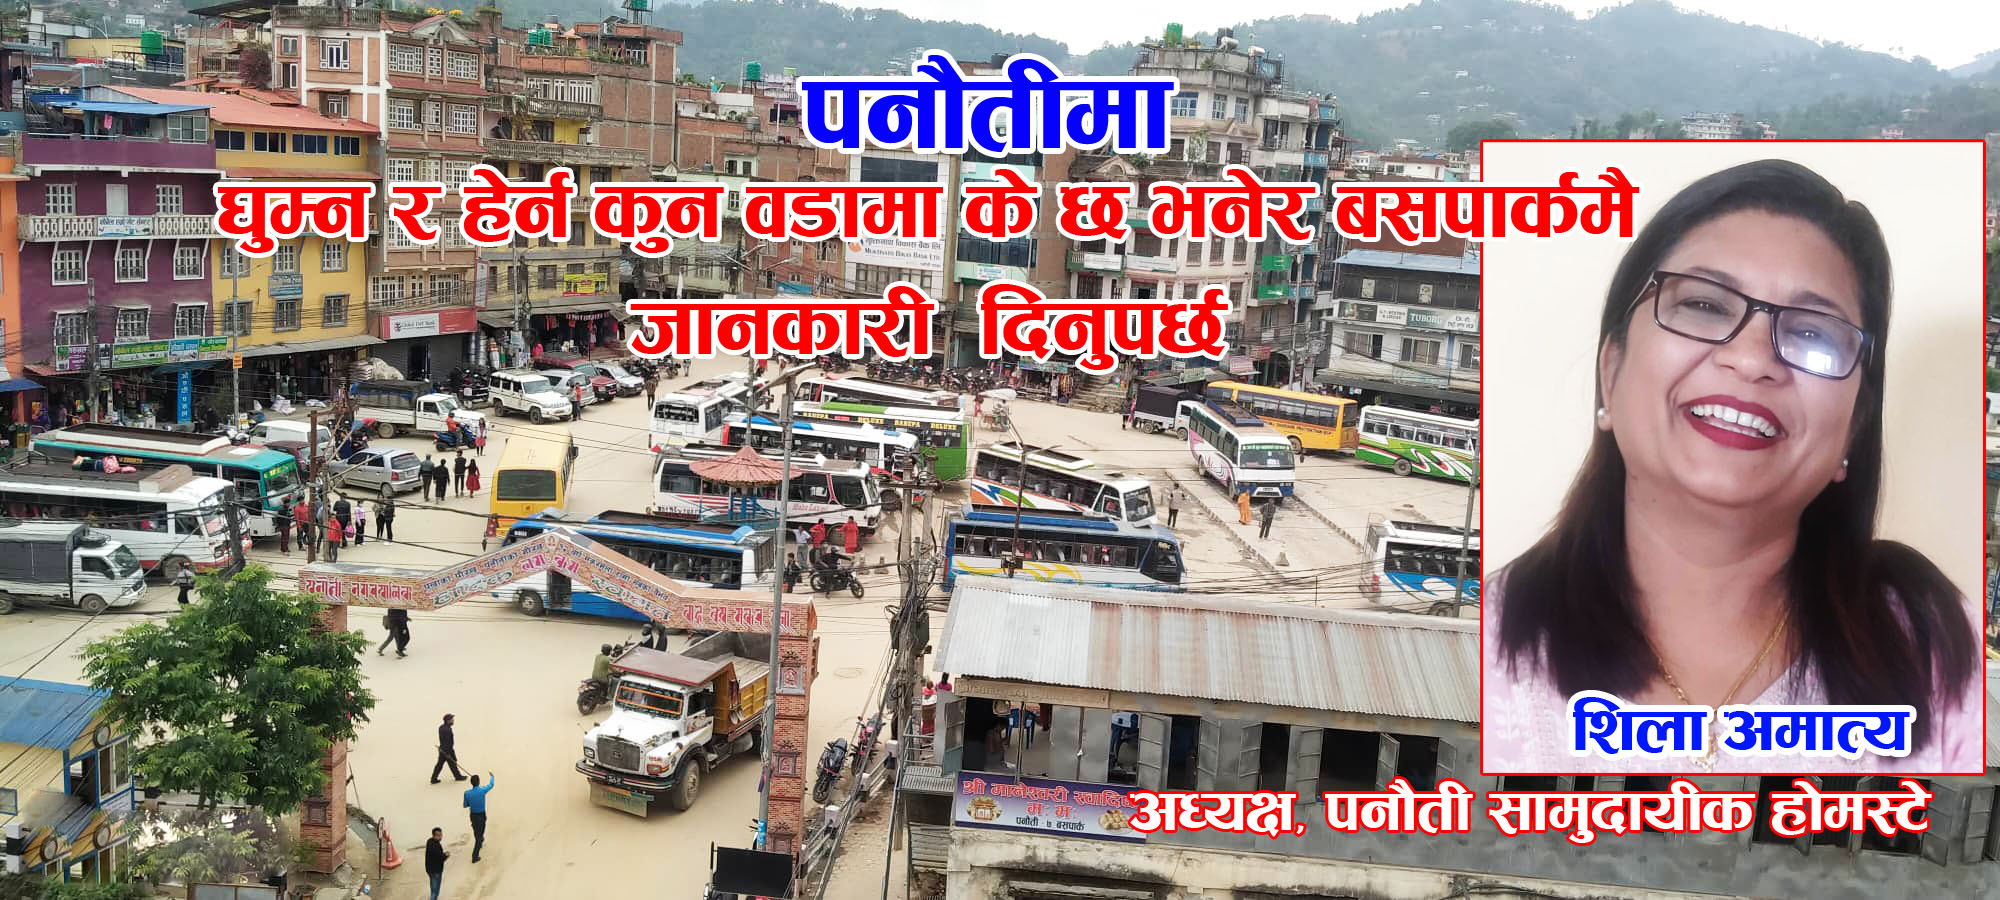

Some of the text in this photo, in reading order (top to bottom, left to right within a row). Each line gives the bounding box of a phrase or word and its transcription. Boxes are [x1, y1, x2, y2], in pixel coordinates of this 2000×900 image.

[962, 777, 986, 796] श्री
[1016, 816, 1039, 828] पनौती
[1056, 820, 1085, 832] बसपार्क
